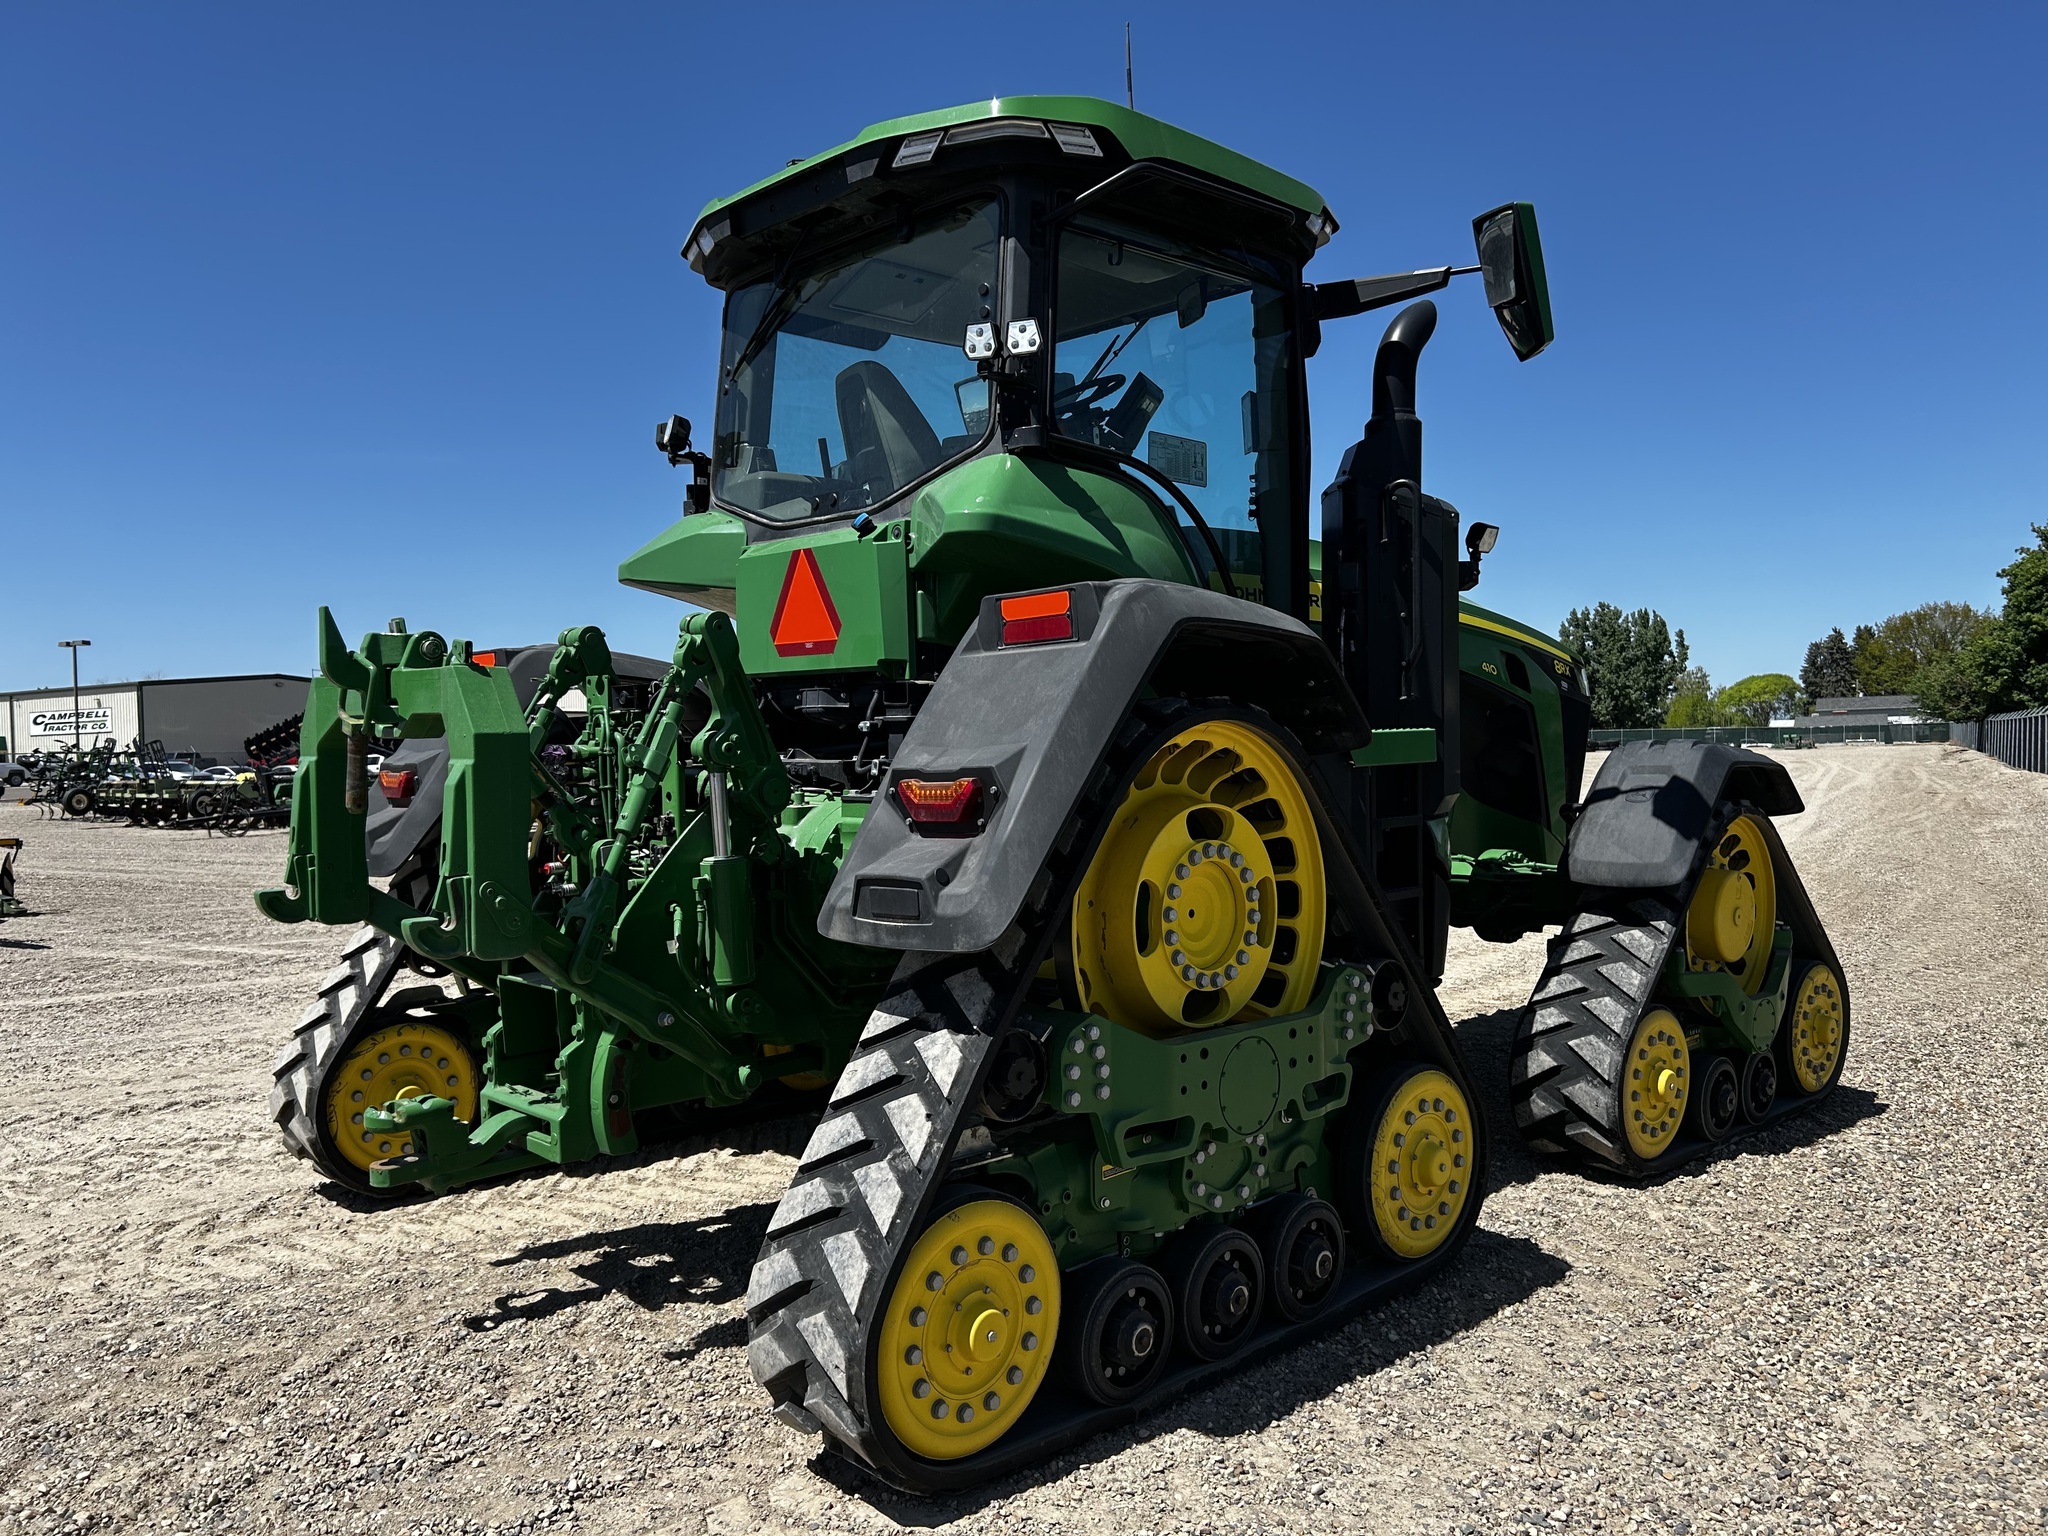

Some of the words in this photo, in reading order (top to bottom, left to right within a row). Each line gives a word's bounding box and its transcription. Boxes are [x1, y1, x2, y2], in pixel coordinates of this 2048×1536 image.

[1482, 662, 1498, 675] 410
[1553, 659, 1571, 677] 8RX
[33, 711, 109, 726] CAMPBELL
